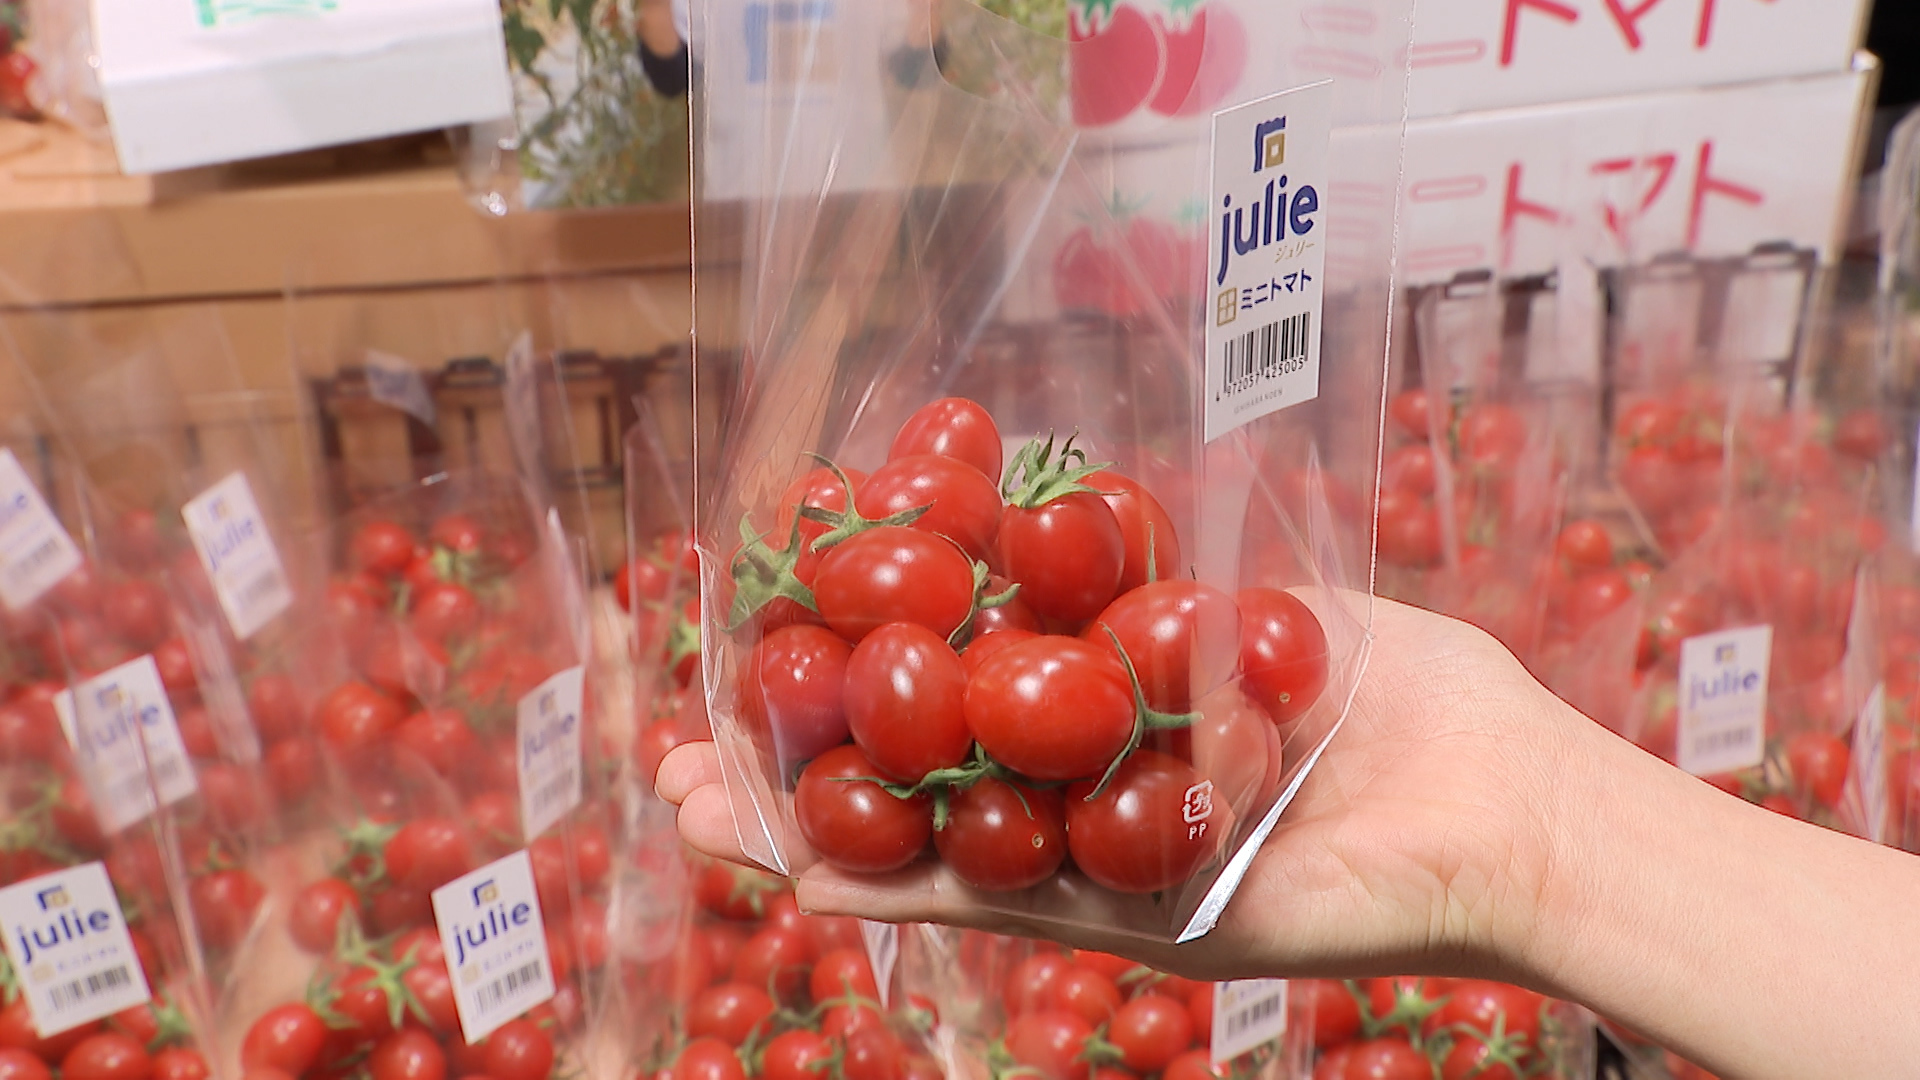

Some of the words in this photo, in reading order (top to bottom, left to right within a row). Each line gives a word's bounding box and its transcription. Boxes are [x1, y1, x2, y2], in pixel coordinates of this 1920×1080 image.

[1217, 174, 1318, 286] julie
[1240, 267, 1312, 310] ミニトマト
[1265, 357, 1304, 380] 425005
[1188, 822, 1207, 840] PP
[15, 908, 110, 965] julie
[452, 901, 531, 968] julie
